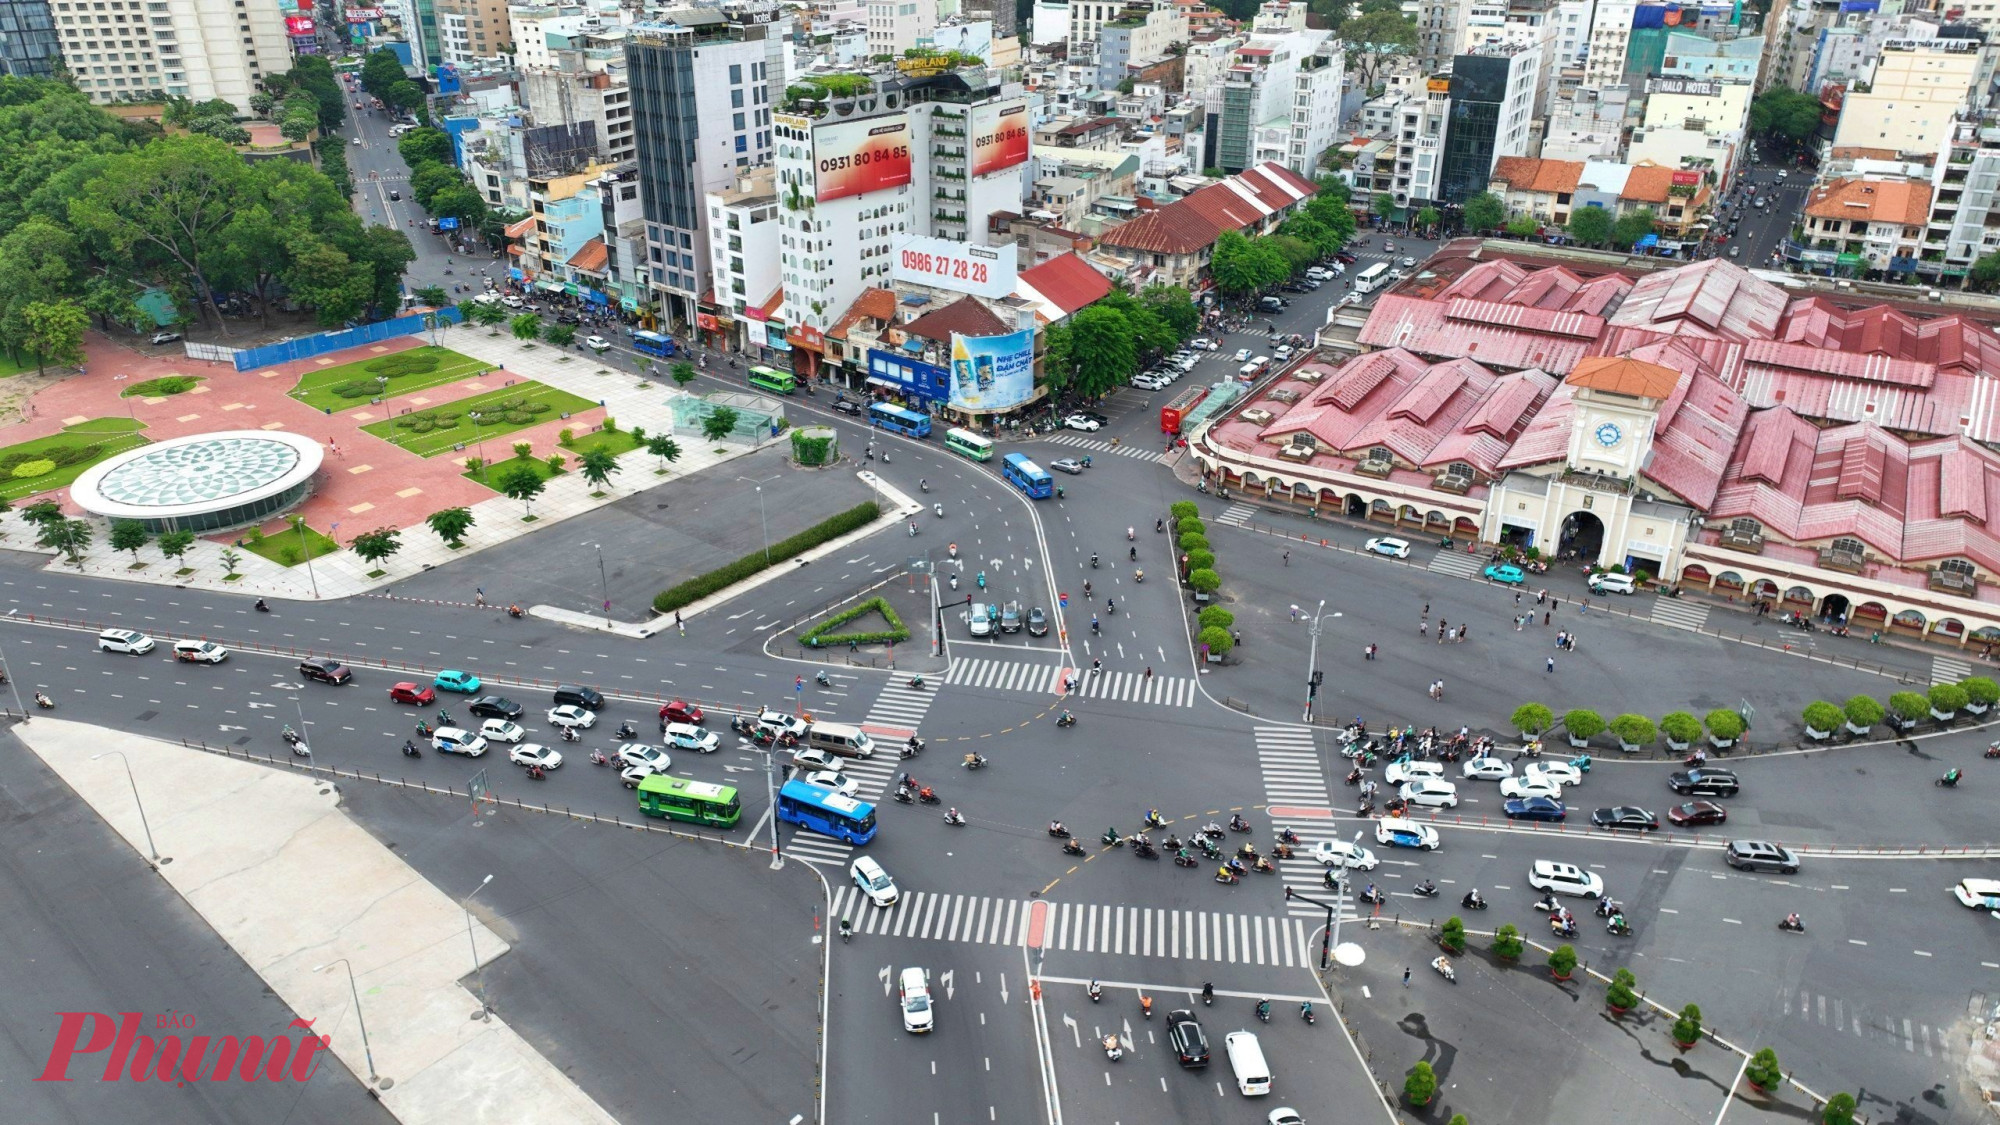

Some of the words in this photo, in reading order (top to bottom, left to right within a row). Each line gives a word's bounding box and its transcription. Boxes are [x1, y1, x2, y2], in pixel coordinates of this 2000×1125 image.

[753, 12, 771, 23] hotel
[1661, 81, 1683, 93] HALO
[1685, 82, 1711, 94] HOTEL
[976, 135, 993, 148] 0931
[995, 132, 1005, 143] 80
[1006, 130, 1015, 140] 84
[1017, 127, 1026, 137] 85
[820, 156, 851, 173] 0931
[854, 151, 870, 166] 80
[874, 148, 889, 162] 84
[893, 145, 907, 159] 85
[902, 249, 932, 273] 0986
[935, 256, 949, 275] 27
[953, 259, 968, 280] 28
[972, 262, 987, 283] 28
[1014, 349, 1031, 360] CHILL
